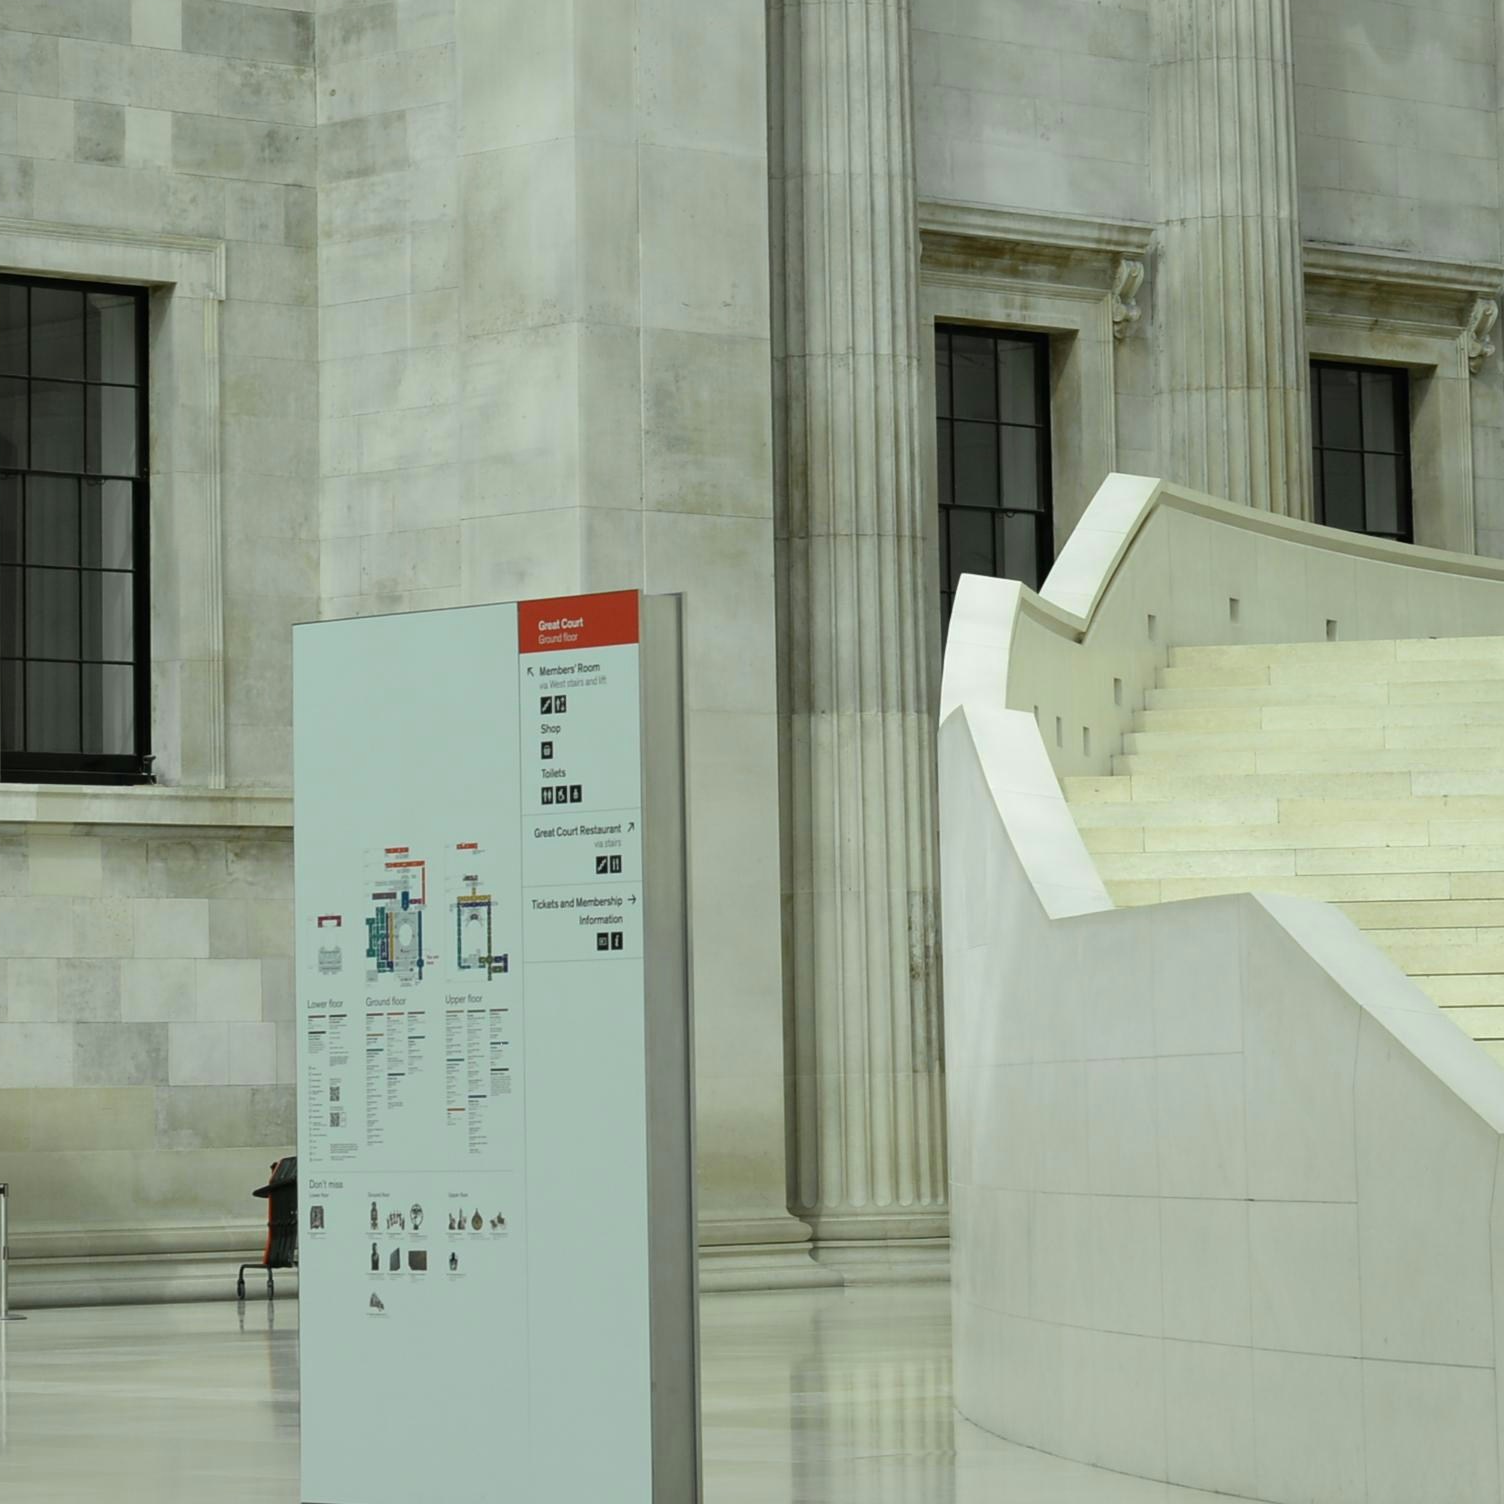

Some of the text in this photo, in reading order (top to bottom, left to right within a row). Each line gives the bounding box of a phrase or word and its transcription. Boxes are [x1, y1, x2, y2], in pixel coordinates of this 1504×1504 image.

[538, 617, 584, 631] Great Court
[538, 631, 578, 645] Ground floor
[577, 662, 600, 673] Room
[549, 679, 566, 689] West
[567, 678, 584, 687] stairs
[585, 676, 597, 686] and
[540, 724, 561, 736] Shop
[541, 768, 566, 779] Toilets
[534, 824, 622, 838] Great Court Restaurant
[594, 838, 622, 848] via stairs
[532, 896, 623, 910] Tickets and Membership
[579, 914, 623, 925] Information
[307, 998, 343, 1009] Lower floor
[365, 996, 406, 1007] Ground floor
[445, 994, 483, 1006] Upper floor
[309, 1179, 327, 1189] Don't
